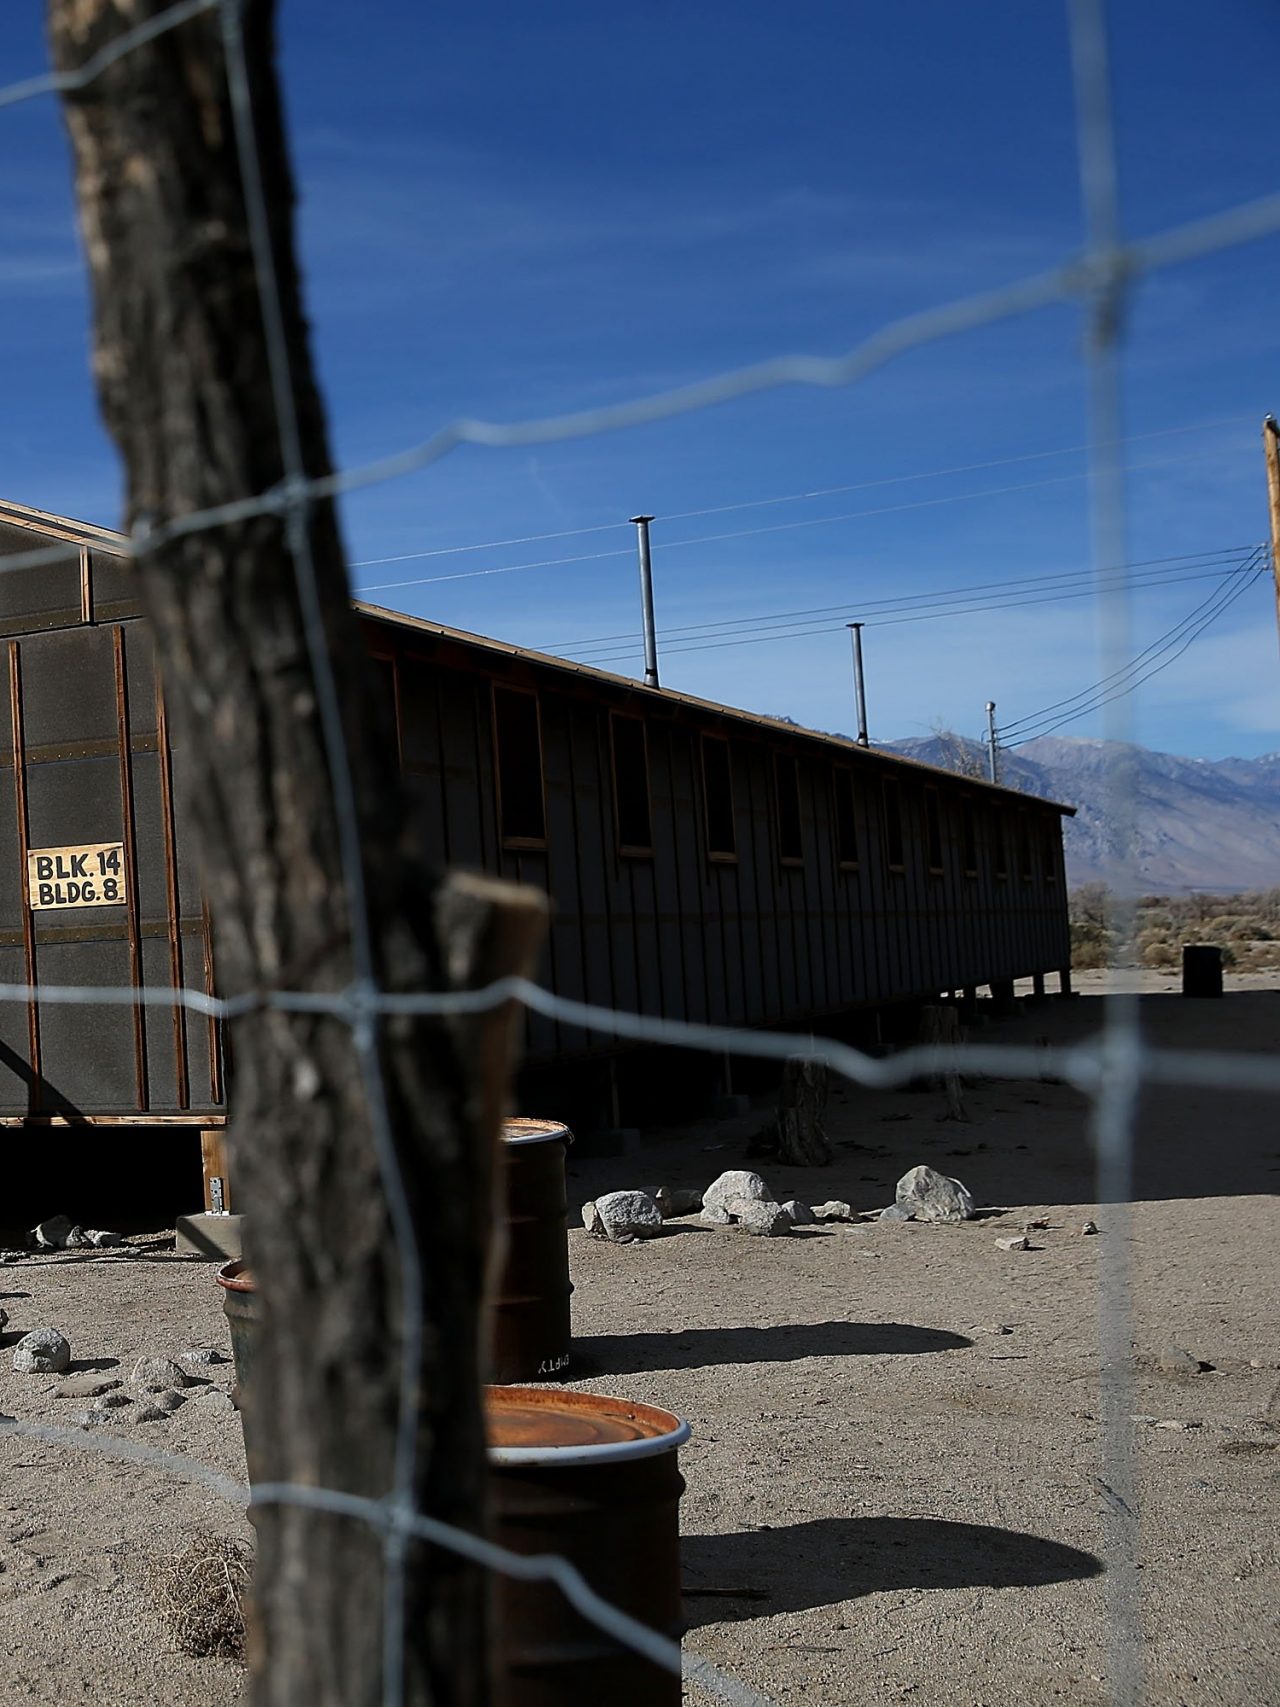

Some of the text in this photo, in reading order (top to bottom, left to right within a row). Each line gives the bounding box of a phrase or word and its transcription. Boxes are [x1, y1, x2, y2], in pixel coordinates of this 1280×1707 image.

[36, 850, 121, 880] BLK. 14
[38, 878, 119, 905] BLDG. 8
